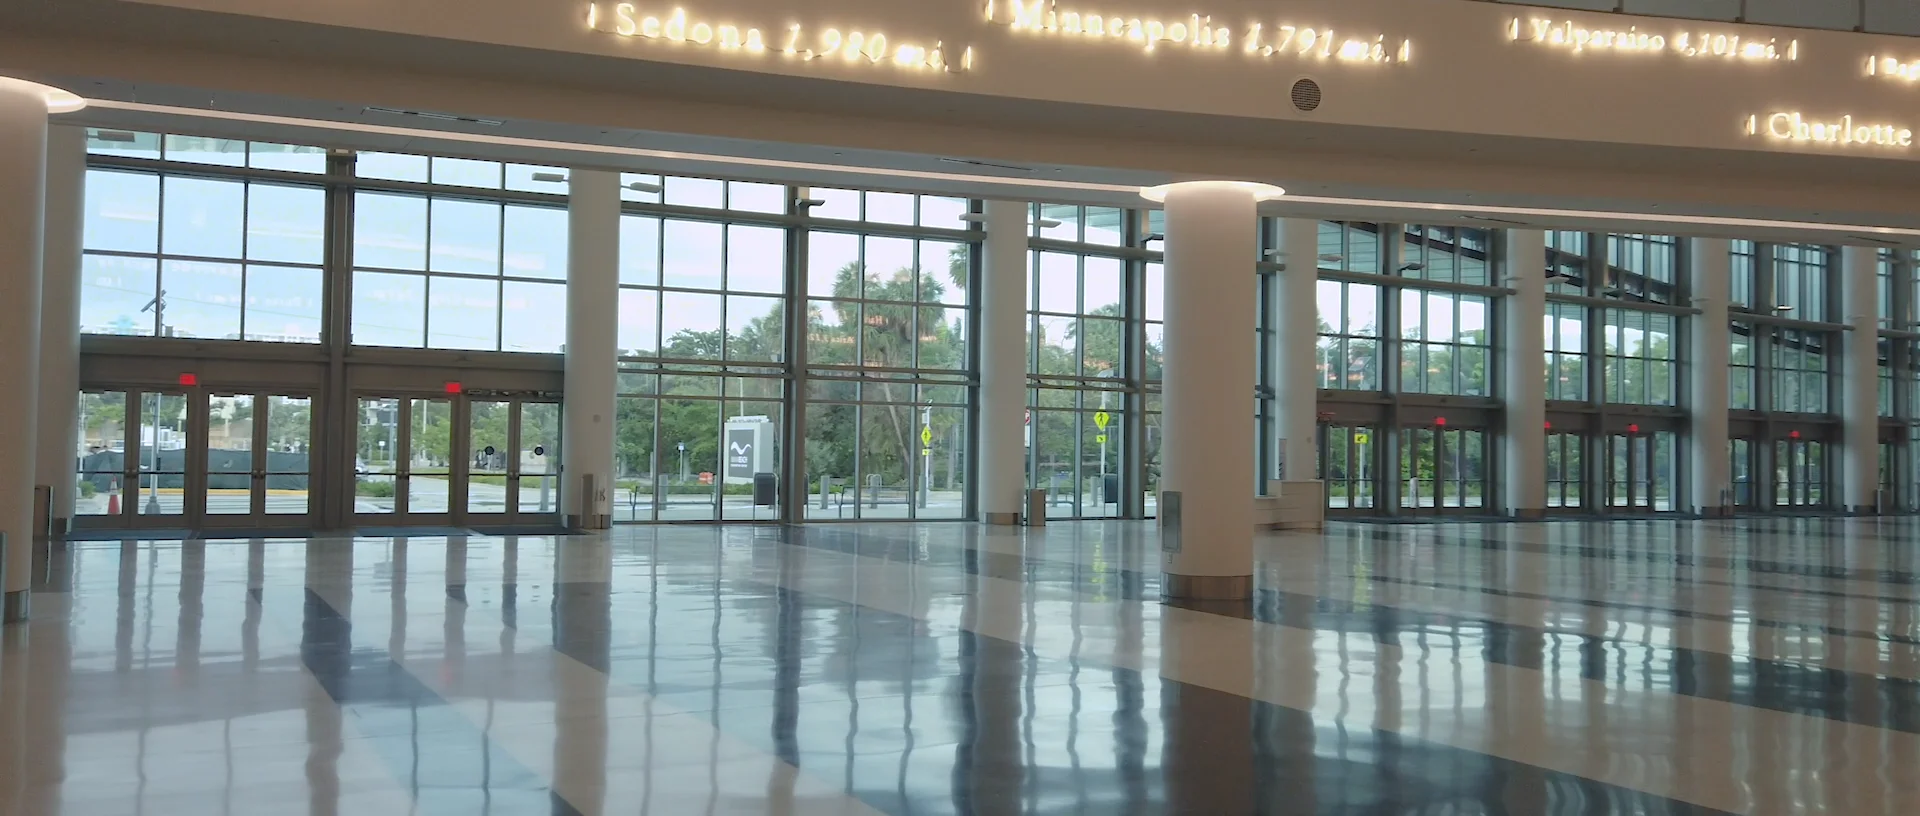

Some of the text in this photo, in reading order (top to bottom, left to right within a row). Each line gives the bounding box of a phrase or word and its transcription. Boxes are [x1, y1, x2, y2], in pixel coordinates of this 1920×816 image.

[615, 2, 765, 50] Sedona
[783, 23, 887, 64] 1,980
[1010, 0, 1230, 51] Minneapolis
[1245, 22, 1334, 58] 1,791
[1530, 18, 1666, 53] Valparaiso
[1672, 31, 1739, 57] 4,101
[1769, 111, 1913, 147] Charlotte
